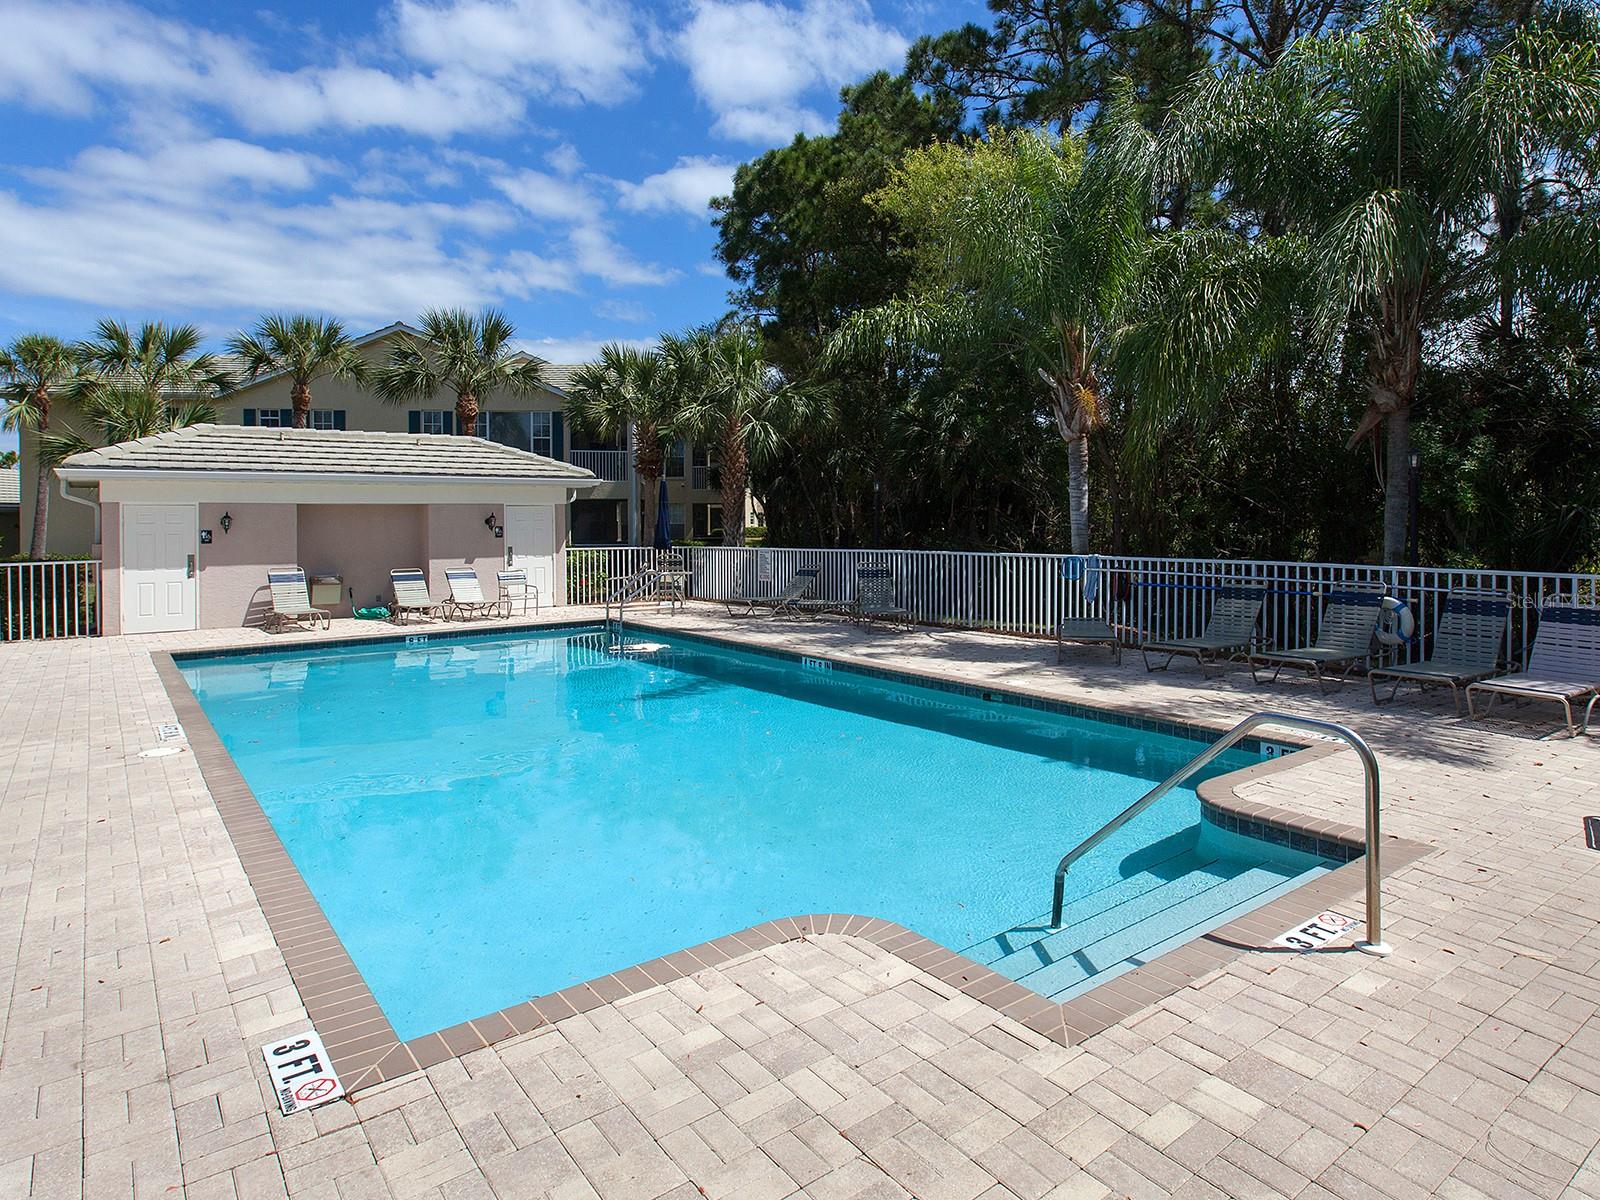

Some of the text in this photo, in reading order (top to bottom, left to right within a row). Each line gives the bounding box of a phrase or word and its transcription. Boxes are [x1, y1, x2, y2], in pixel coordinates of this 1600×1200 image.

[1299, 922, 1338, 941] FT.
[1285, 936, 1314, 949] 3
[272, 1039, 323, 1085] 3 FT.
